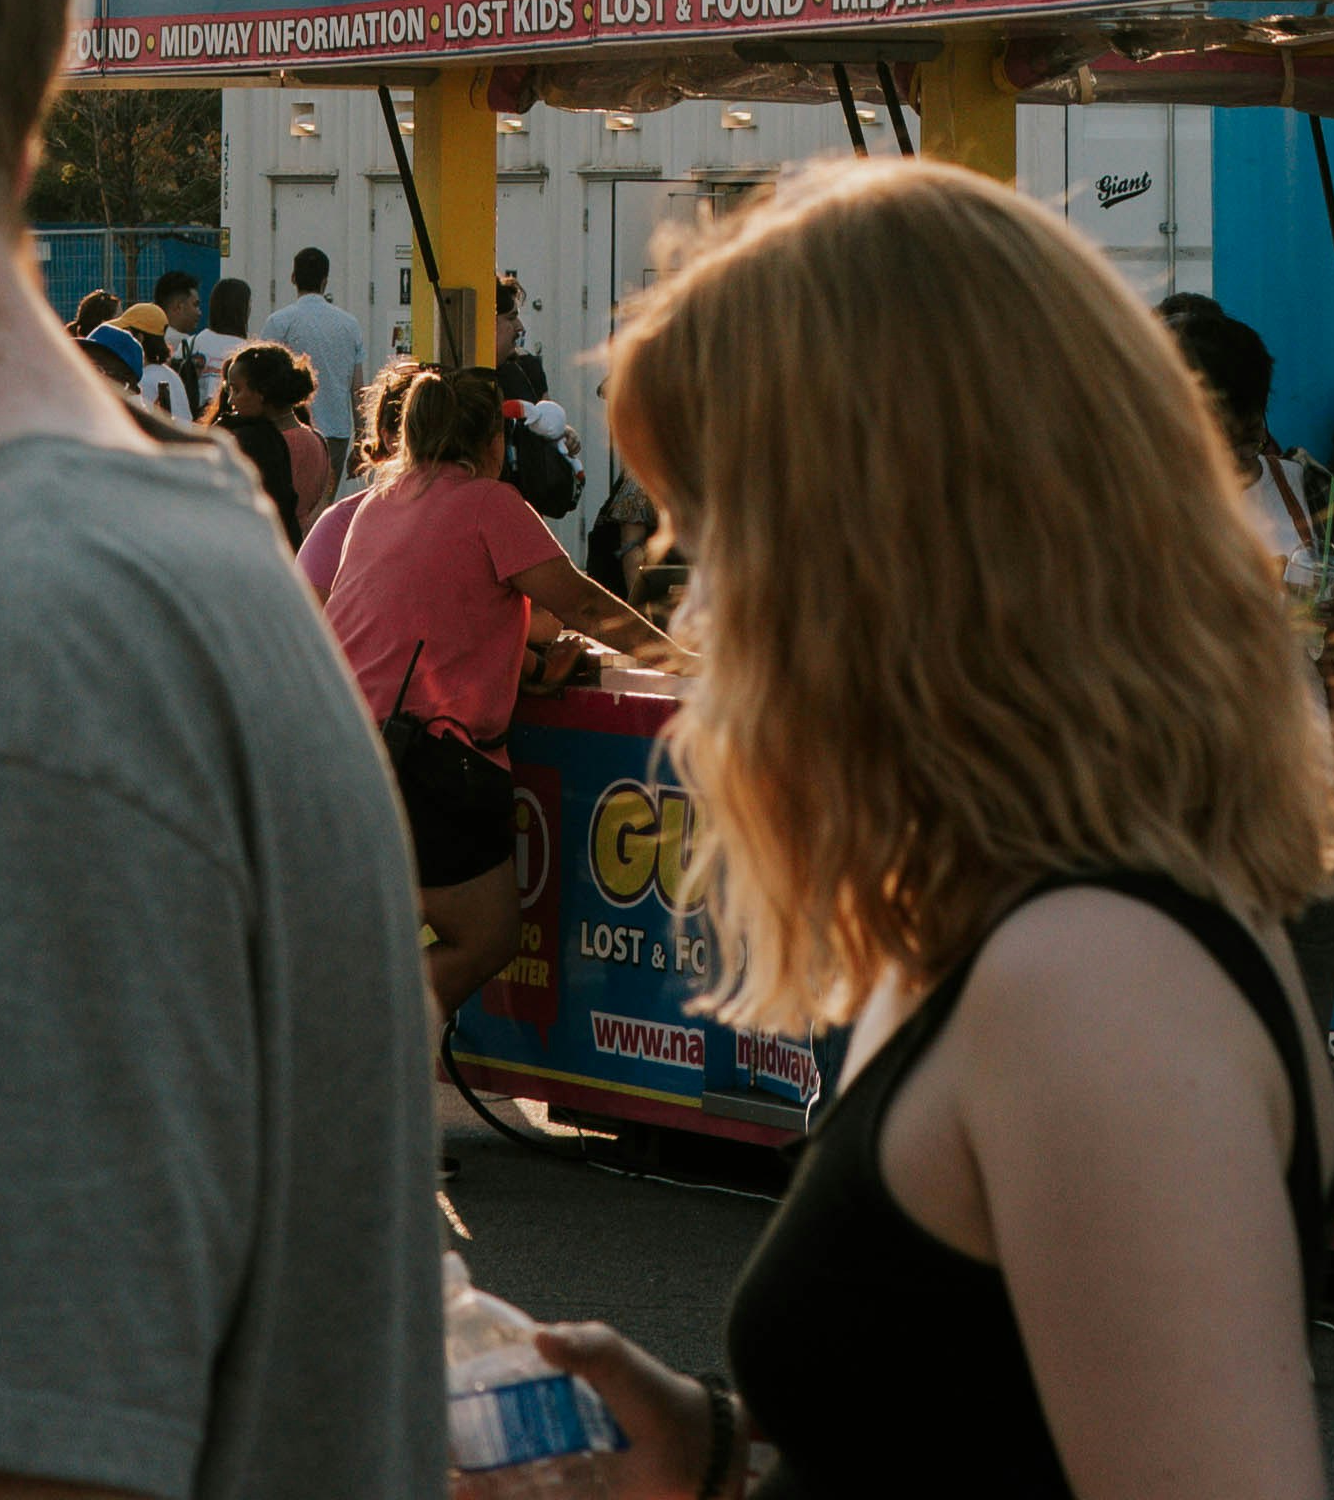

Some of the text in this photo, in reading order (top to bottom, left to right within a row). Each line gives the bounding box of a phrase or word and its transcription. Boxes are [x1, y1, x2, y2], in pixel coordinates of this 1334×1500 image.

[160, 21, 253, 59] MIDWAY
[257, 7, 425, 55] INFORMATION
[444, 0, 507, 39] LOST
[1095, 171, 1152, 203] Giant
[579, 921, 644, 964] LOST
[651, 943, 666, 969] &
[495, 959, 550, 989] ENTER
